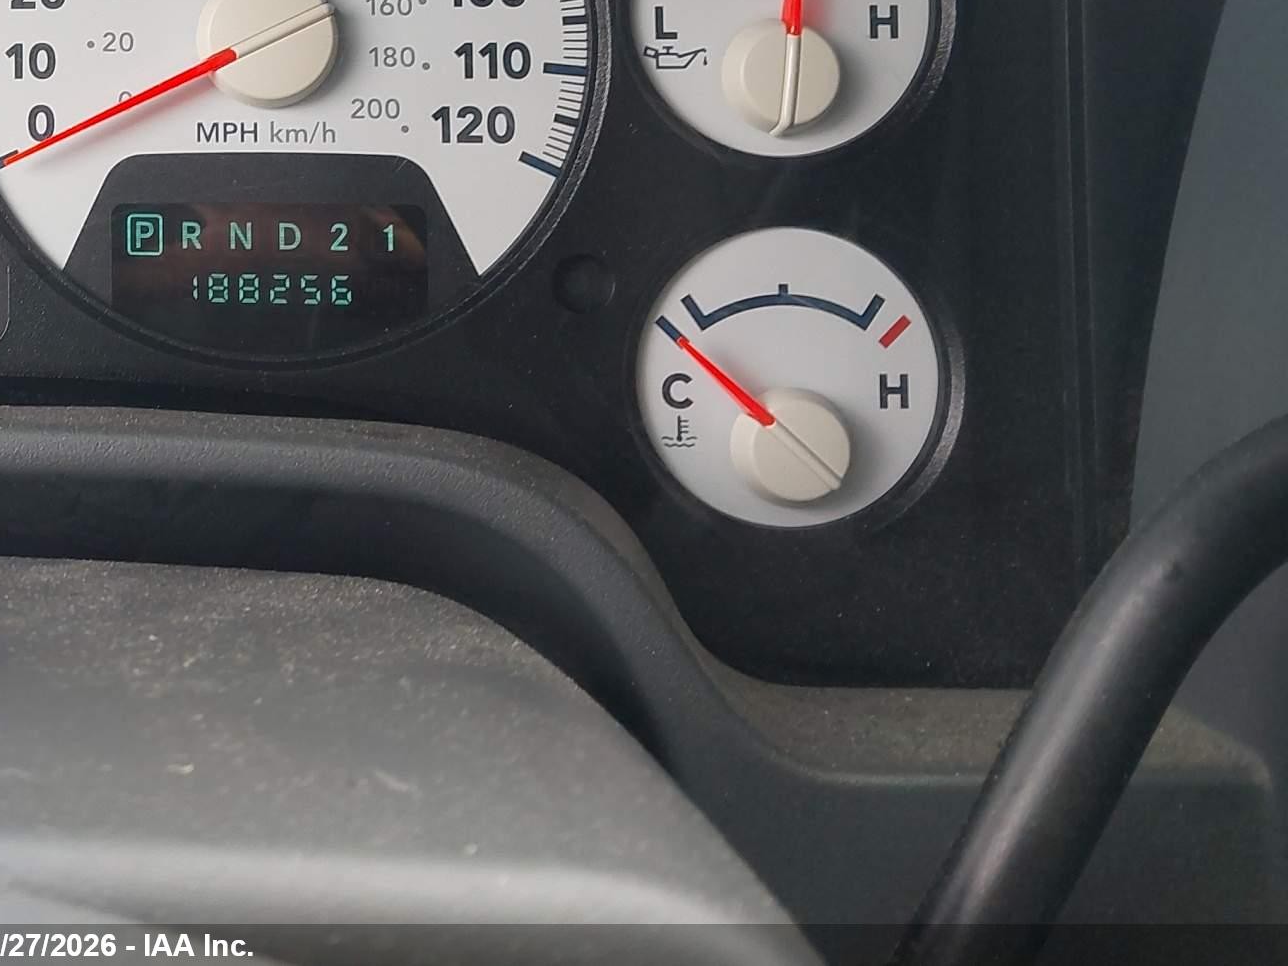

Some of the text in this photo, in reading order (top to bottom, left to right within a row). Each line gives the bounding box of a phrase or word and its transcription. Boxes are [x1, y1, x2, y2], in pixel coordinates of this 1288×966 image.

[655, 6, 677, 39] L
[870, 5, 898, 39] H
[103, 32, 133, 52] 20
[369, 47, 415, 67] 180
[6, 43, 56, 79] 10
[454, 42, 531, 79] 110
[28, 105, 54, 141] 0
[351, 98, 400, 119] 200
[432, 106, 515, 144] 120
[197, 121, 335, 144] MPH km/h
[136, 221, 393, 251] P R N D 2 1
[193, 274, 351, 304] 188256
[662, 373, 693, 409] C
[880, 374, 909, 409] H
